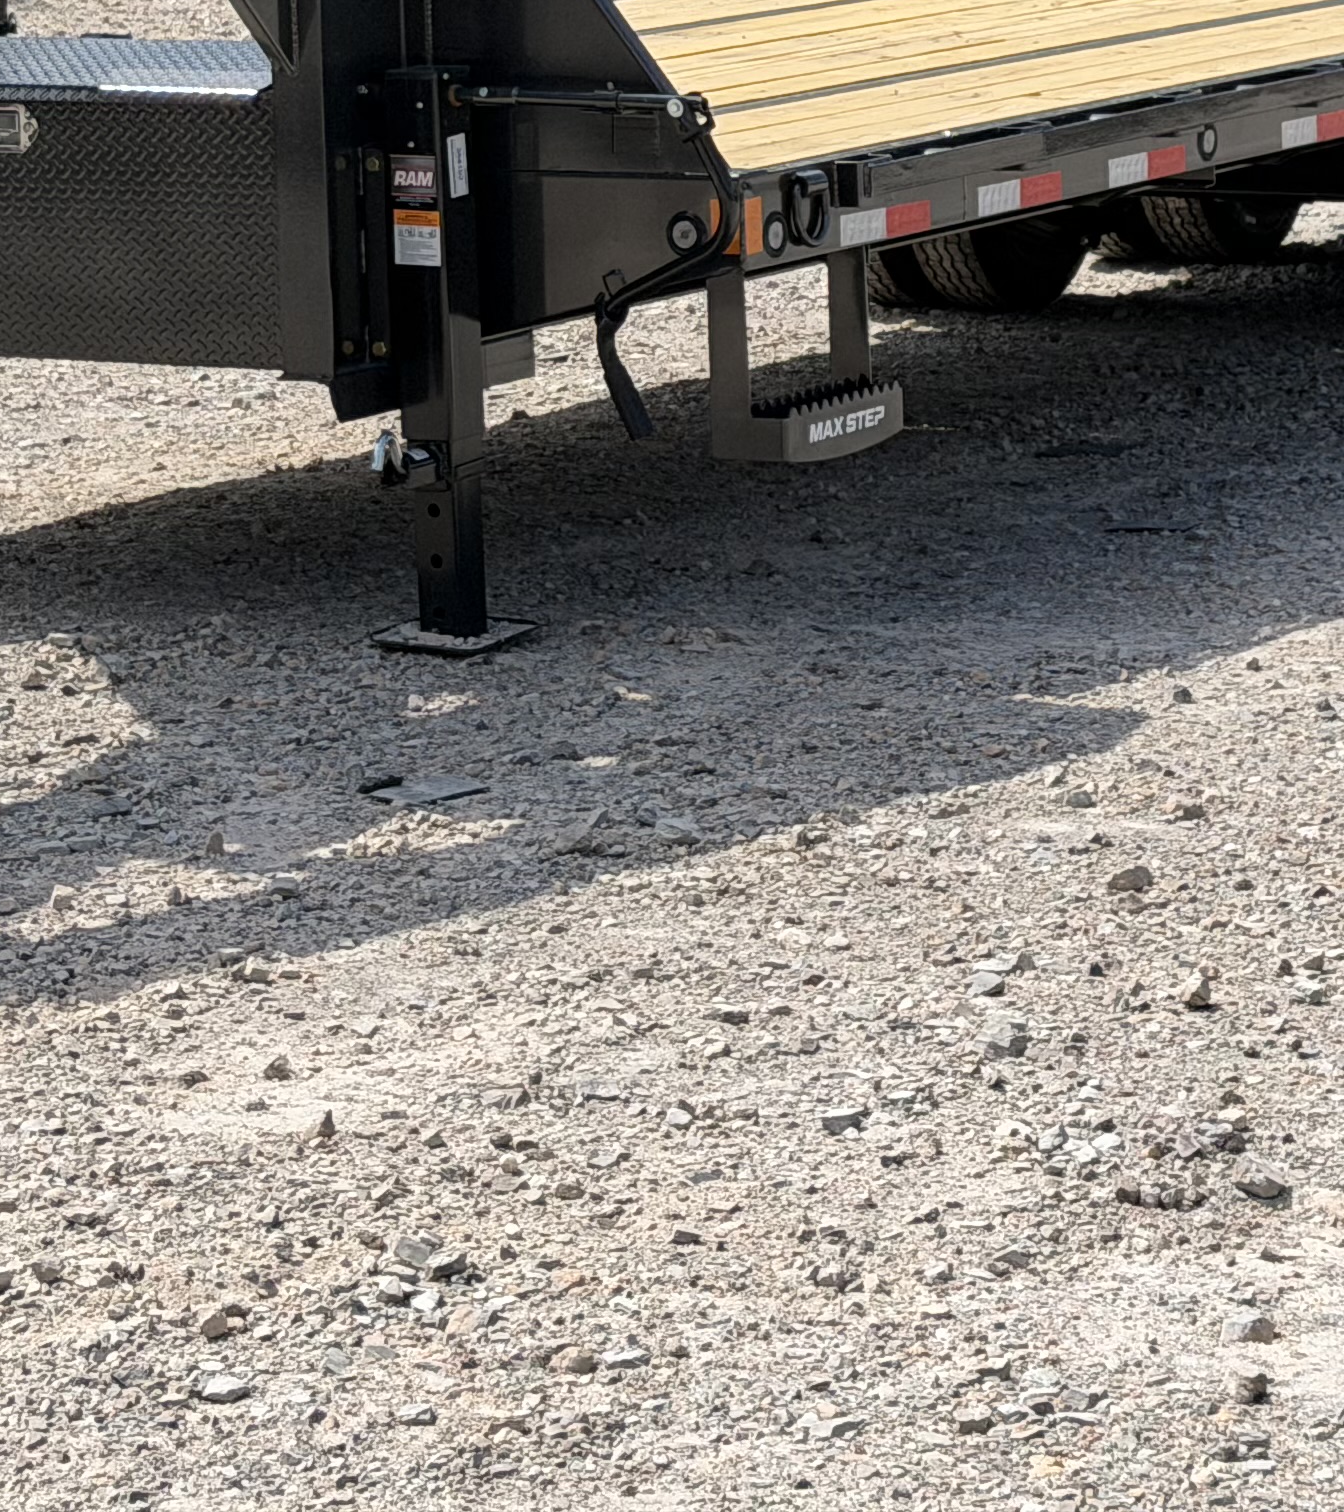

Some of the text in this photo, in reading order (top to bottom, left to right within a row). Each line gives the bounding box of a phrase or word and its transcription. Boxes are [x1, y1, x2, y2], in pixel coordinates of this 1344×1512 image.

[394, 170, 434, 187] RAM
[809, 405, 886, 444] MAX STEP
